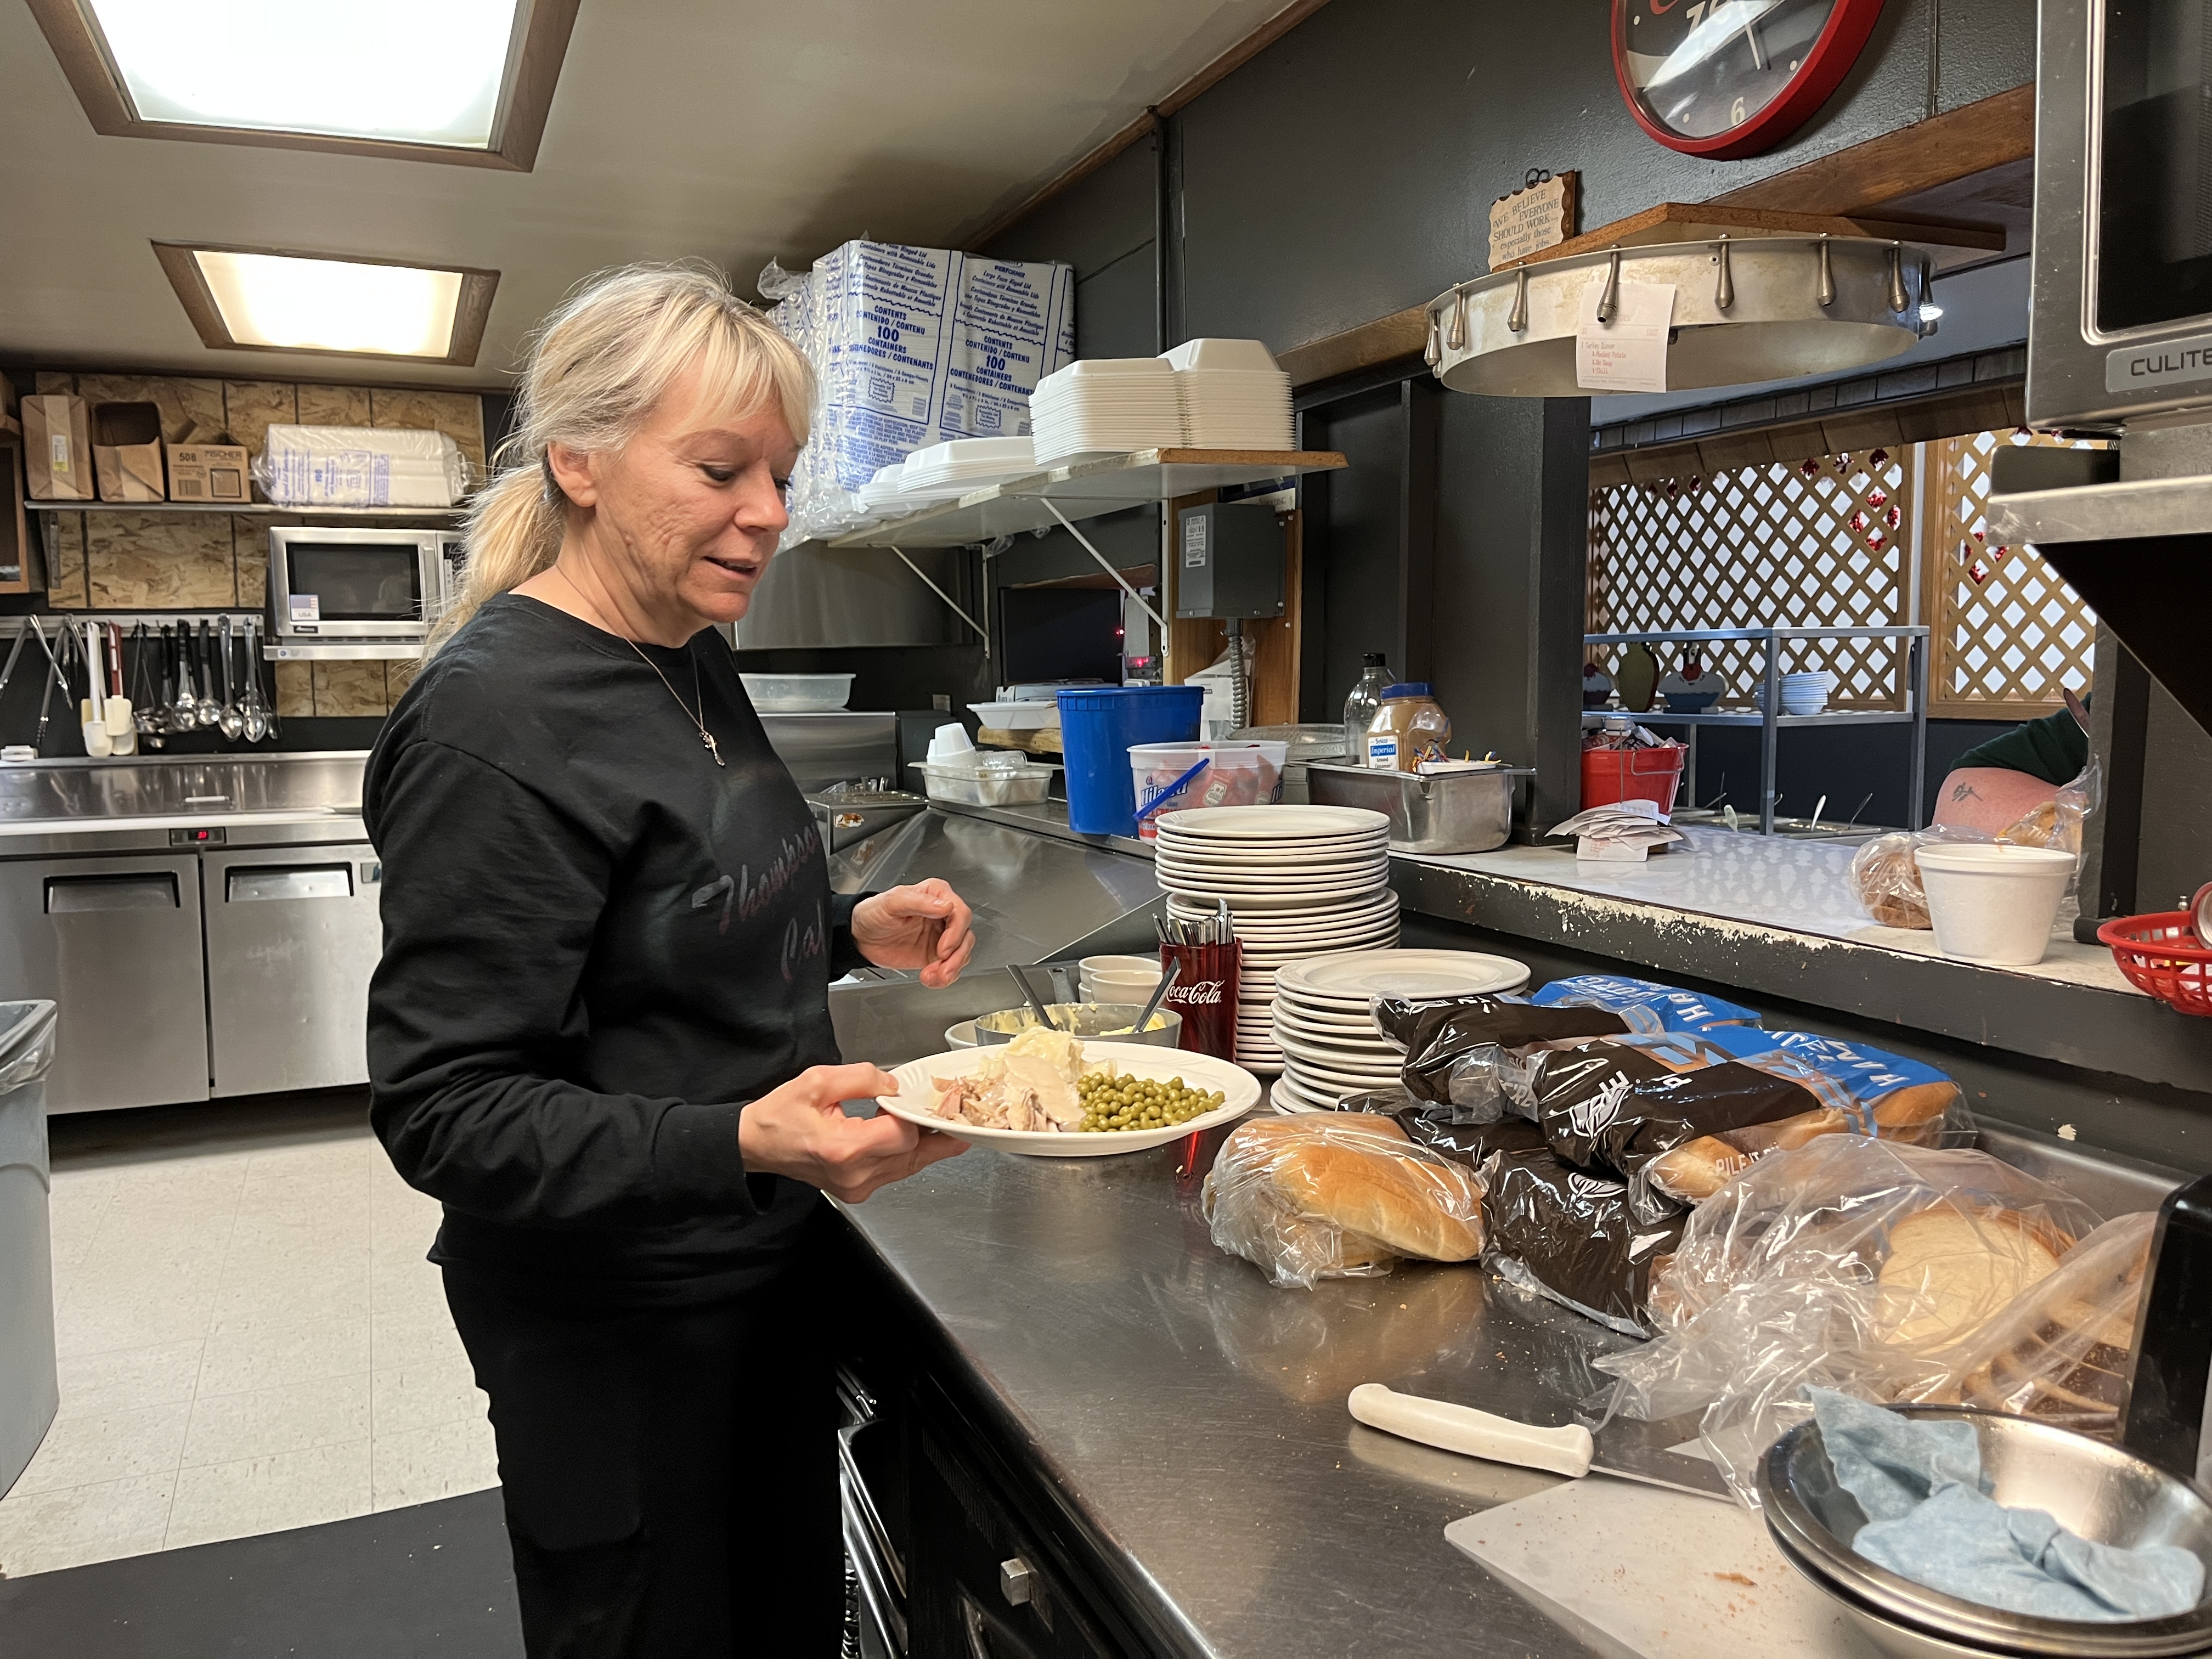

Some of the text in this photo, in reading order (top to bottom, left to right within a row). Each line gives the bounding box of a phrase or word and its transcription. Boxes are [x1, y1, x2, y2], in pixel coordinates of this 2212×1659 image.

[1730, 97, 1746, 127] 6
[1493, 189, 1547, 228] WE BELIEVE
[1519, 198, 1560, 222] EVERYONE
[1493, 223, 1524, 242] SHOULD
[1500, 227, 1551, 250] especially those
[1502, 250, 1515, 261] who
[1517, 245, 1532, 256] have
[994, 264, 1026, 279] PERFORMER
[856, 309, 889, 326] CONTENIDO
[896, 320, 926, 335] CONTENU
[874, 305, 907, 321] CONTENTS
[877, 325, 900, 342] 100
[984, 335, 1013, 350] CONTENTS
[868, 336, 907, 354] CONTAINERS
[966, 339, 998, 356] CONTENIDO
[1003, 350, 1030, 364] CONTENU
[893, 353, 934, 370] CONTENANTS
[986, 354, 1006, 371] 100
[2130, 347, 2212, 376] CULITE
[950, 368, 994, 387] CONTENEDORES
[976, 366, 1012, 382] CONTAINERS
[1371, 744, 1395, 755] Imperial
[1166, 979, 1226, 1005] Coca-Cola
[1716, 1154, 1747, 1176] PILE
